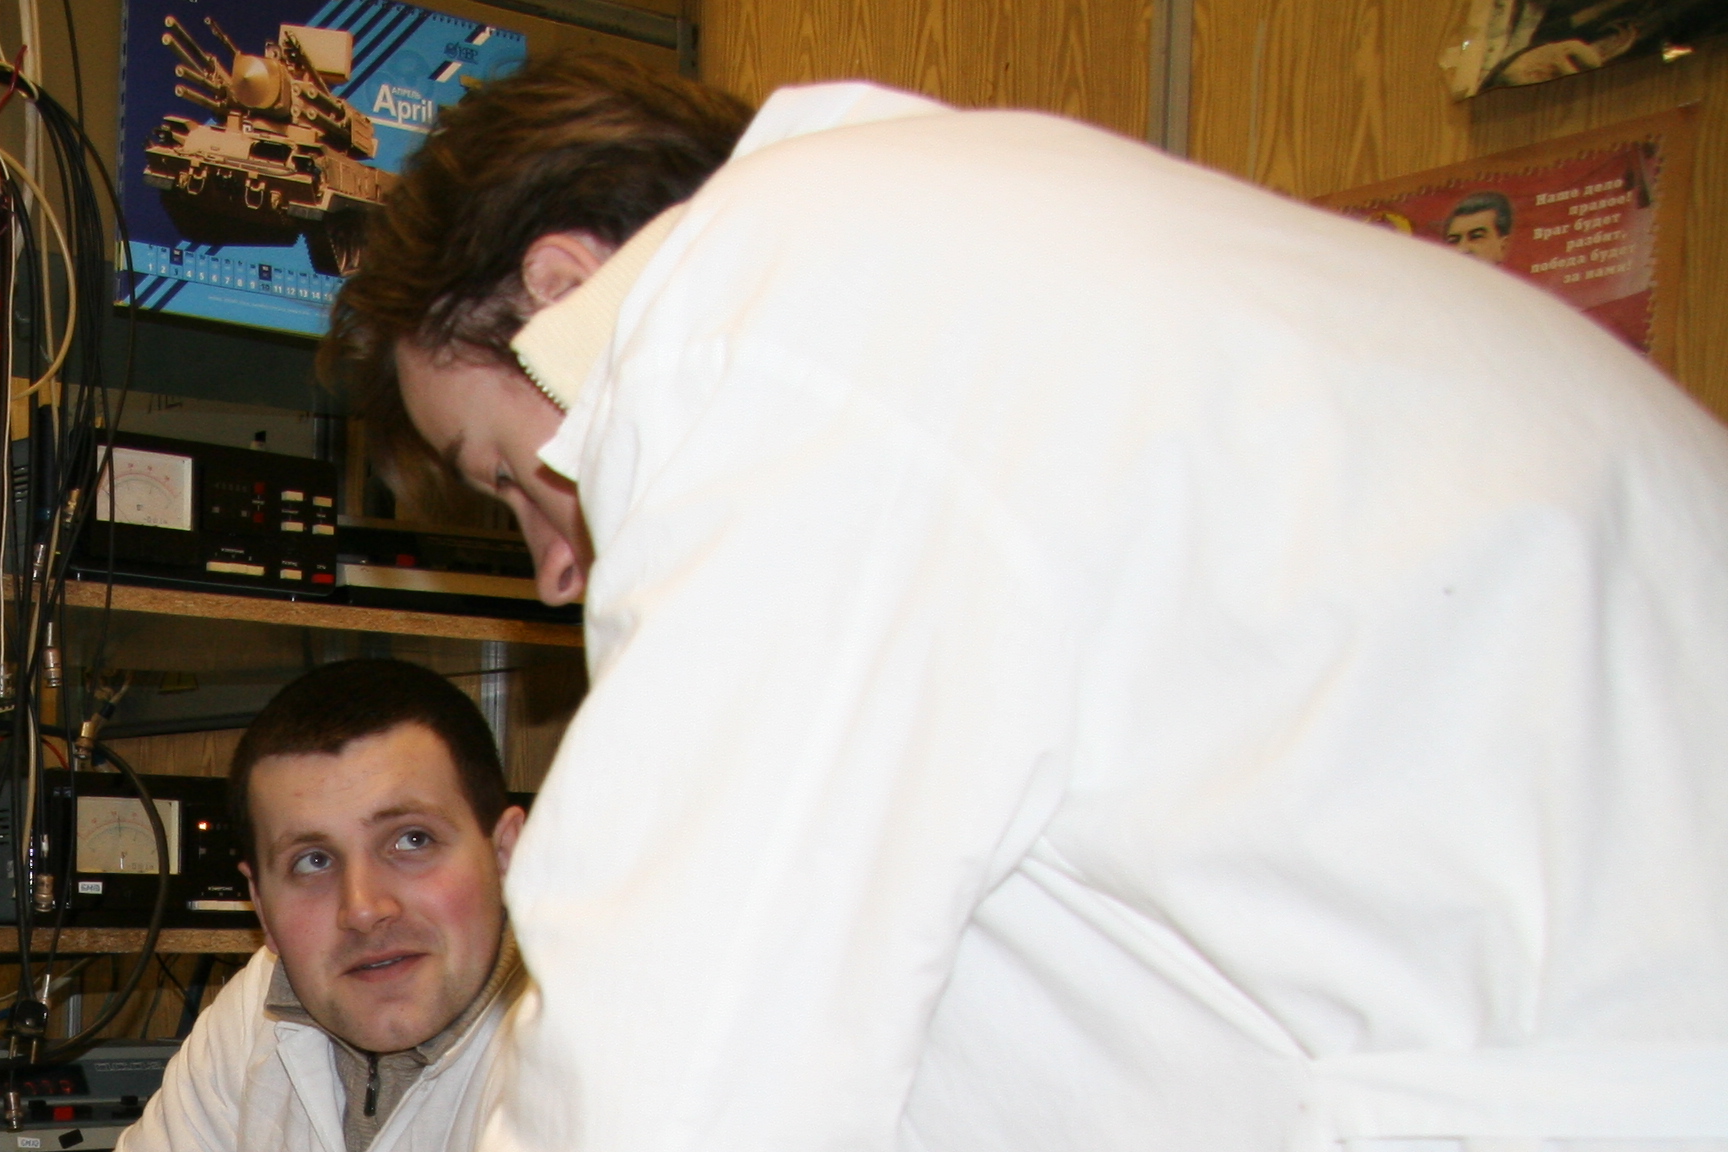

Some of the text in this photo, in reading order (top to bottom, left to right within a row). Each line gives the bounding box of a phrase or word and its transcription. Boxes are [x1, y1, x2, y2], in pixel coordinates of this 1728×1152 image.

[373, 83, 433, 124] April
[1536, 179, 1623, 205] Наше дело
[1568, 190, 1633, 216] правое!
[1533, 213, 1622, 241] Враг будет
[1530, 243, 1636, 274] победа будет
[1562, 272, 1580, 284] за
